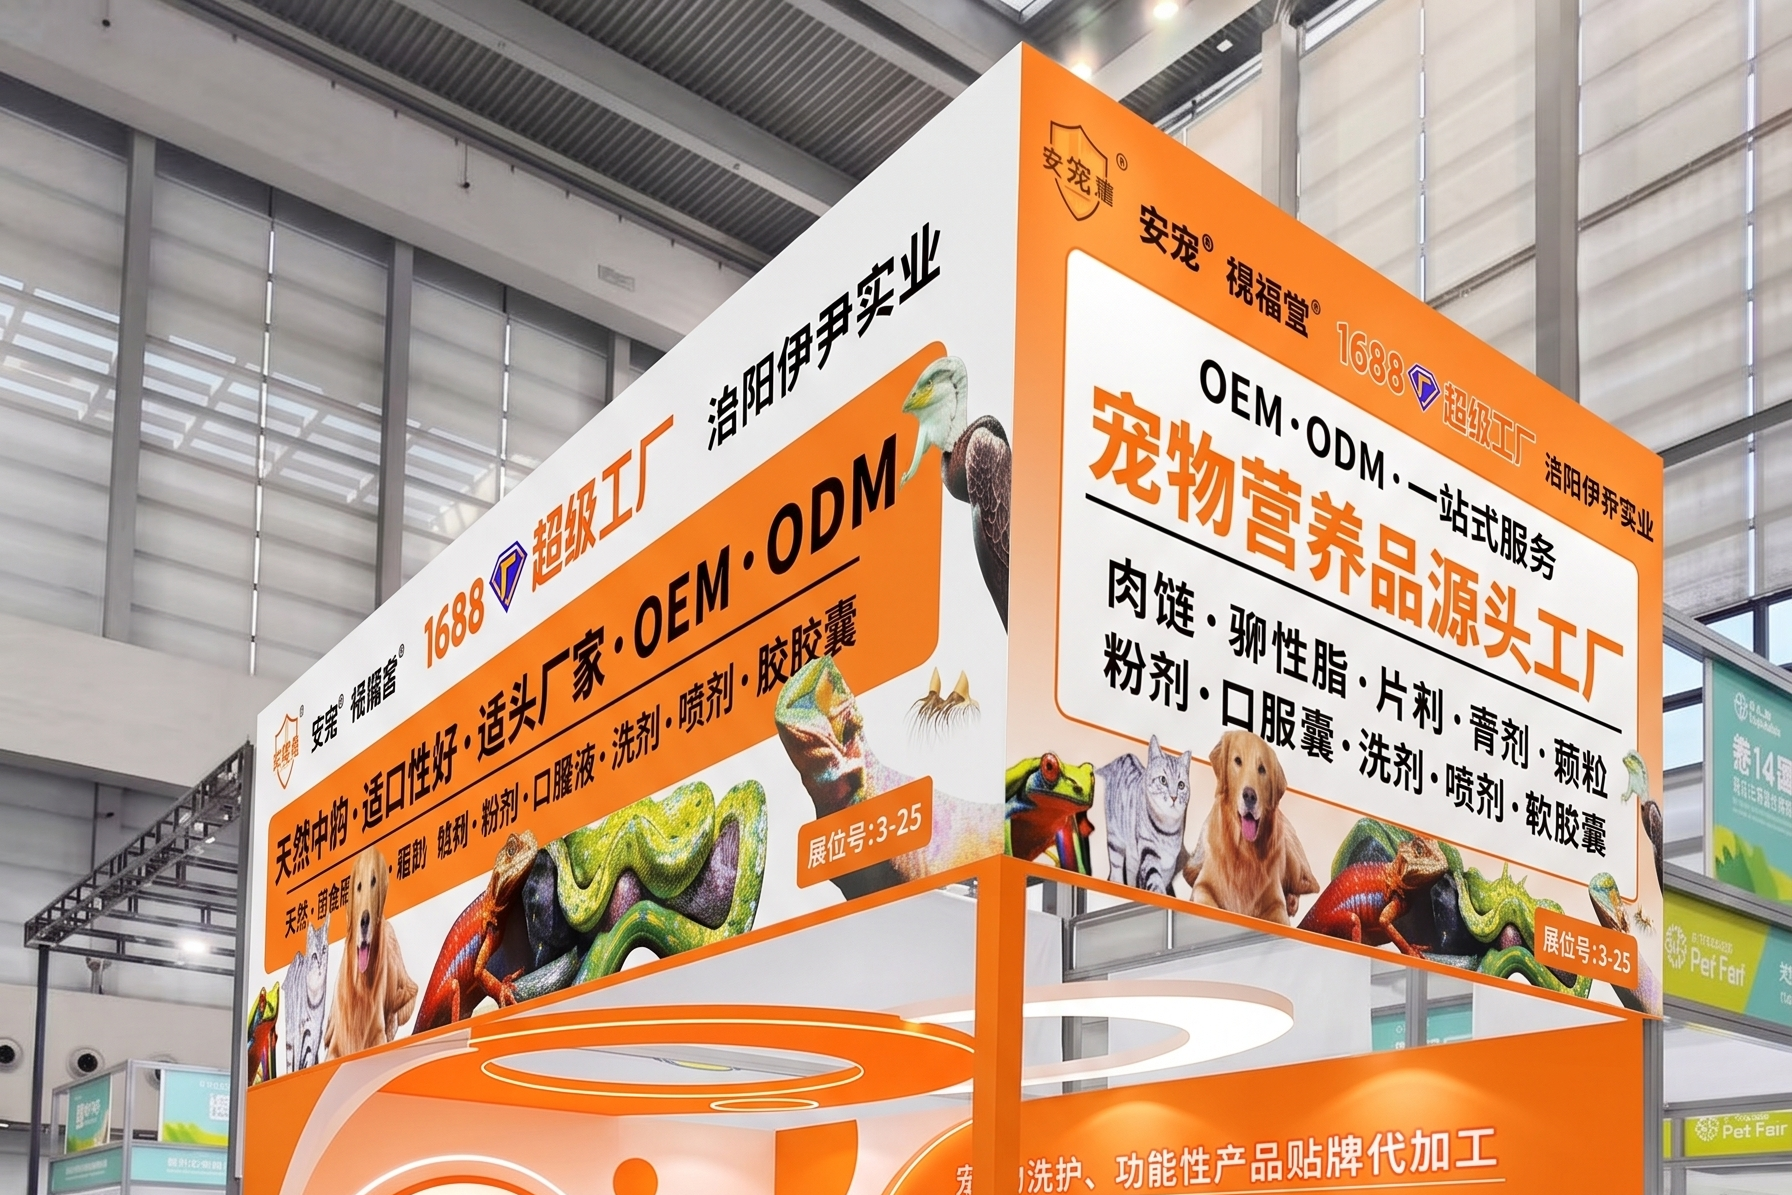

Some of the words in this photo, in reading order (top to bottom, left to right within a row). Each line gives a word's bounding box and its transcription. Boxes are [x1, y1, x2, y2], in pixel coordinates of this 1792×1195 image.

[1336, 321, 1405, 396] 1688
[1443, 381, 1537, 467] 超级工厂
[424, 577, 484, 669] 1688
[531, 414, 674, 593] 超级工厂
[1090, 385, 1625, 703] 宠物营养品源头工厂
[1722, 1124, 1750, 1139] Pet
[1756, 1121, 1788, 1138] Fair
